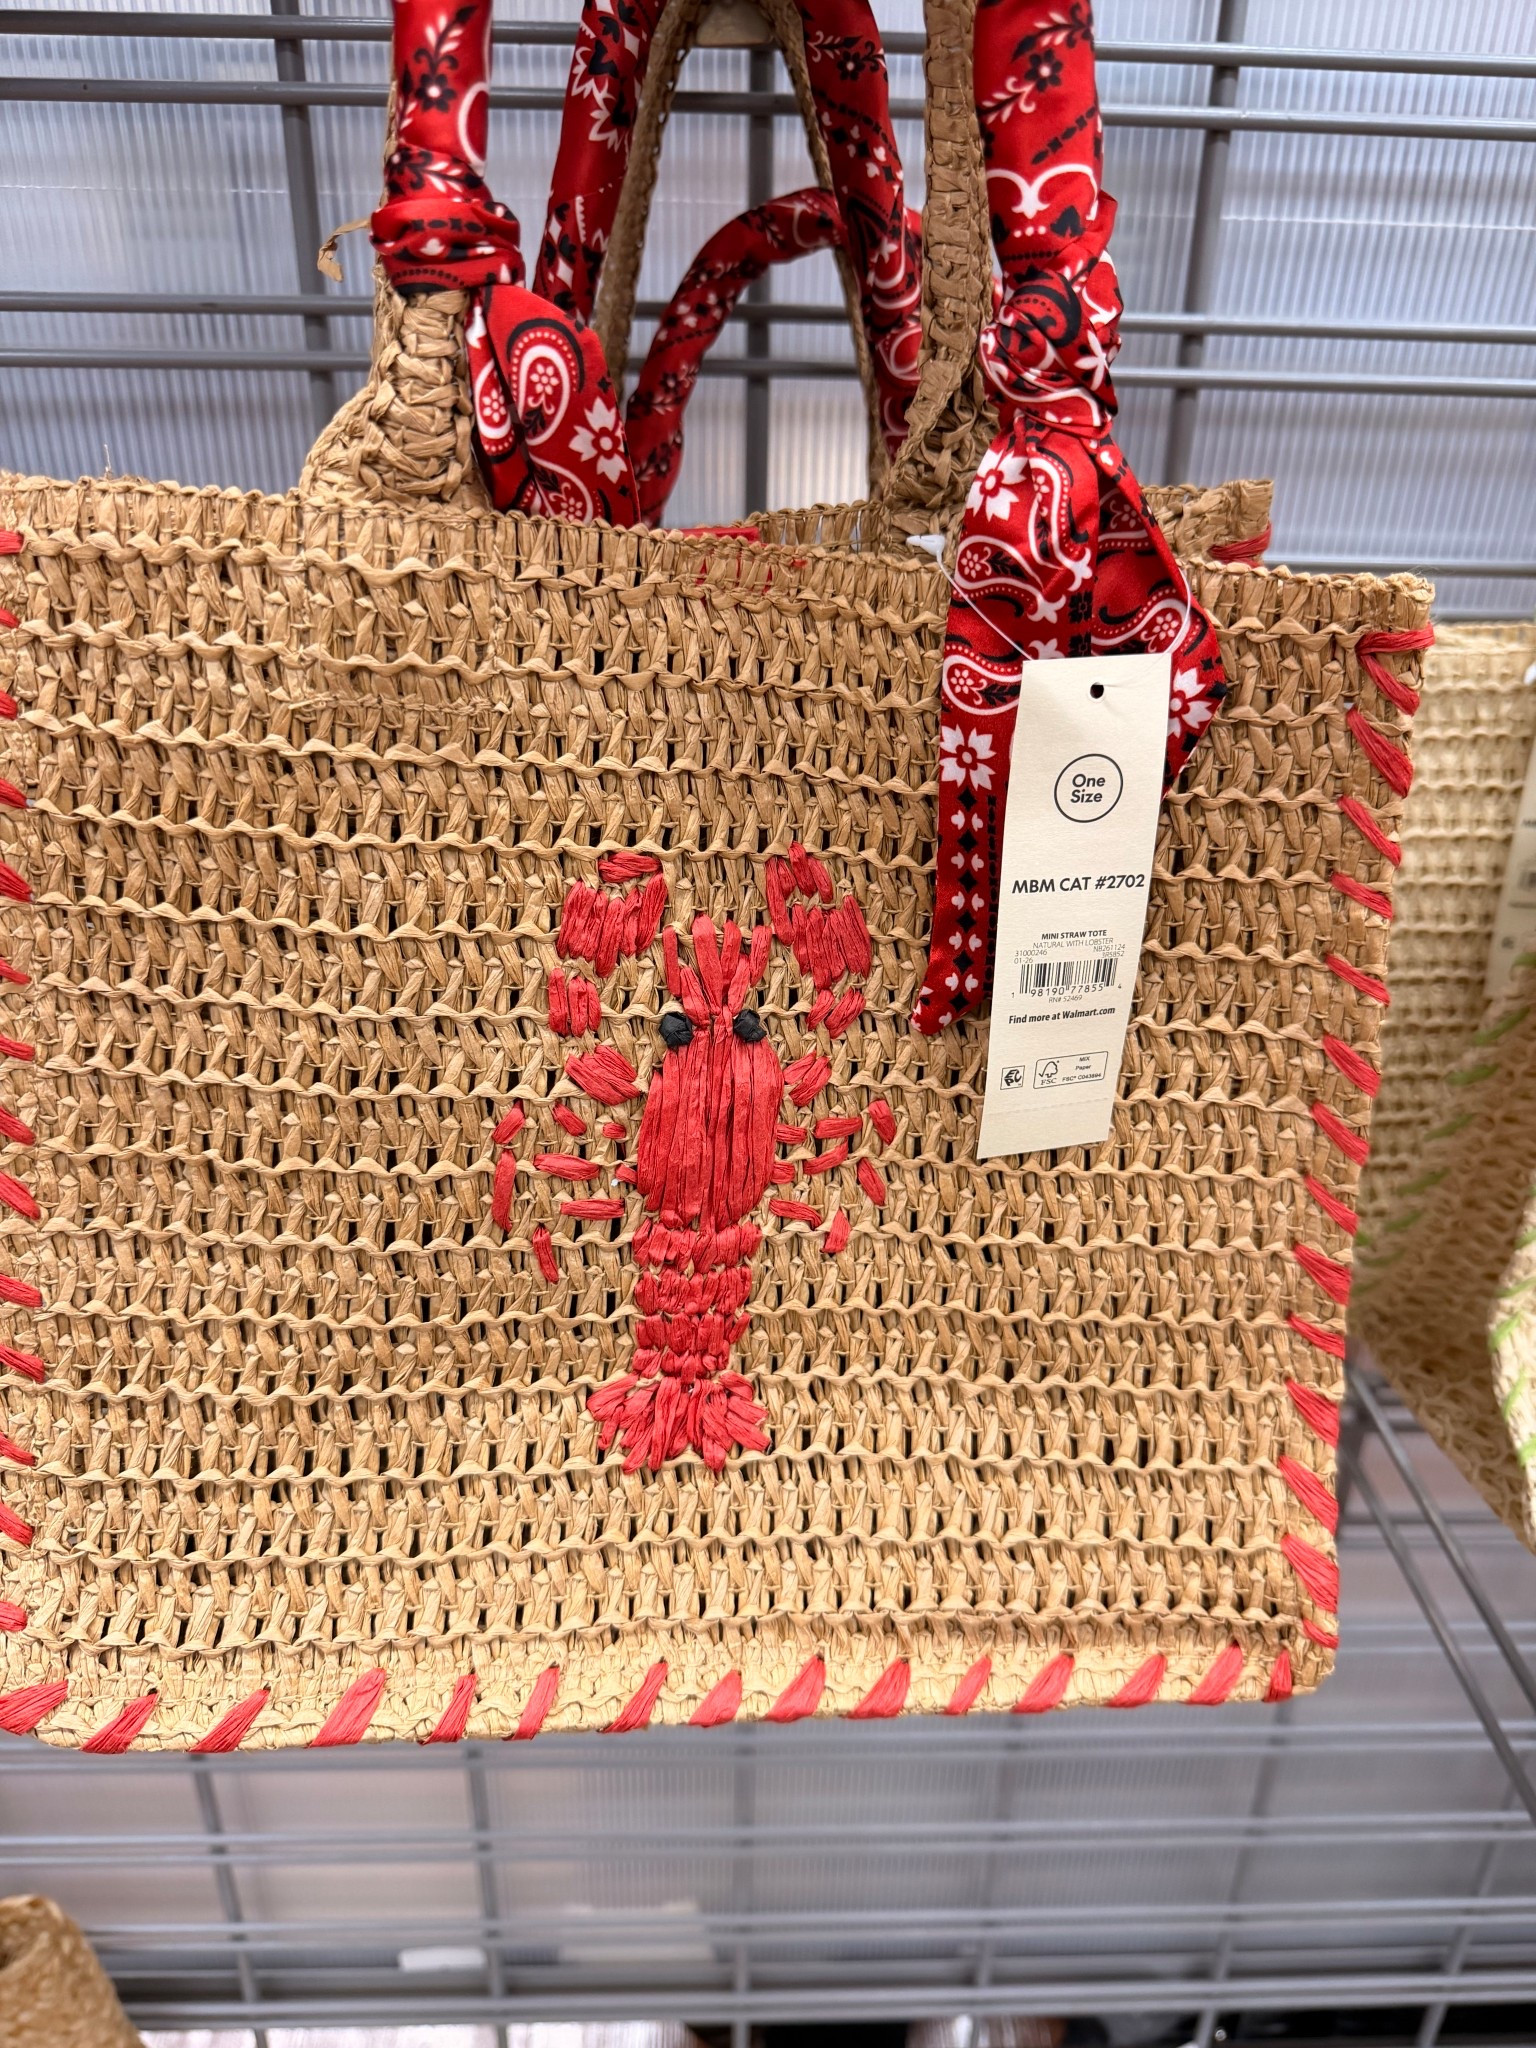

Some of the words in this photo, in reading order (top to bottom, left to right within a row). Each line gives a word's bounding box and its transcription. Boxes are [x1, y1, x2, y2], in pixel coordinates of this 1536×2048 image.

[1072, 773, 1106, 787] One
[1070, 790, 1103, 804] Size
[1012, 879, 1055, 894] MBM
[1059, 877, 1091, 892] CAT
[1095, 874, 1145, 889] #2702
[1061, 931, 1086, 939] STRAW
[1033, 941, 1064, 949] NATURAL
[1085, 938, 1113, 946] LOBSTER
[1015, 949, 1047, 957] 31000246
[1031, 987, 1064, 997] 98190
[1071, 984, 1103, 994] 77855
[1009, 1014, 1026, 1024] Find
[1028, 1014, 1050, 1022] more
[1063, 1008, 1115, 1019] Walmart.com
